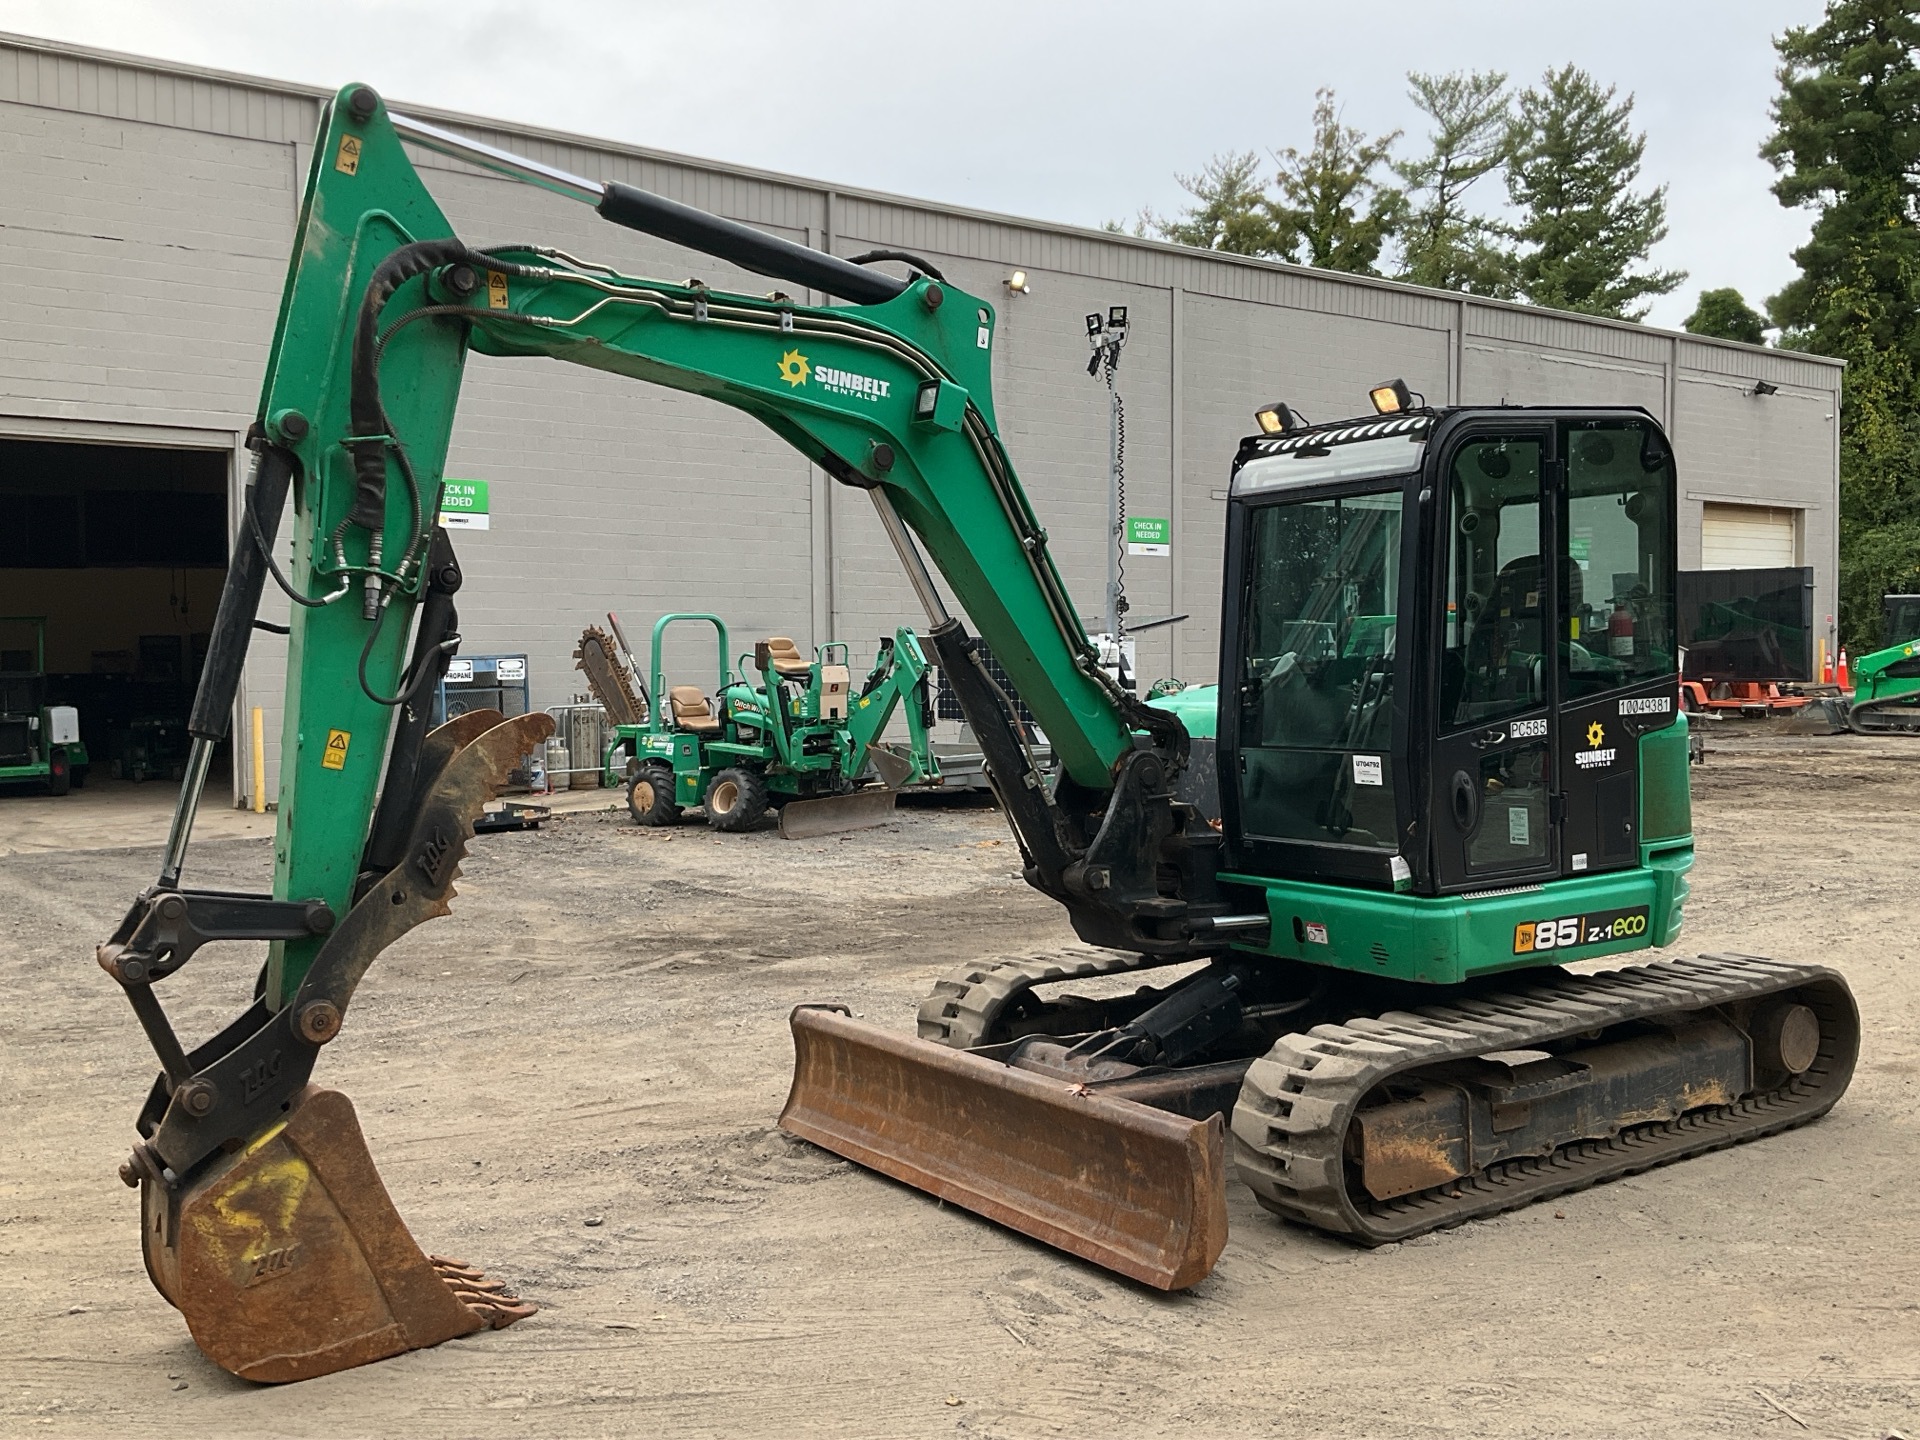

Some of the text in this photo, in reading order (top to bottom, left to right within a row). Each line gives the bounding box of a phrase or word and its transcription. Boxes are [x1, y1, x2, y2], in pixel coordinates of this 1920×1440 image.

[815, 365, 890, 397] SUNBELT
[824, 384, 878, 402] RENTALS
[464, 485, 475, 495] IN
[1133, 521, 1153, 530] CHECK
[1136, 531, 1160, 539] NEEDED
[445, 672, 472, 680] PROPANE
[1621, 698, 1669, 714] 10049381
[1511, 721, 1547, 736] PC585
[1575, 749, 1616, 765] SUNBELT
[1581, 760, 1611, 769] RENTALS
[1535, 918, 1578, 950] 85
